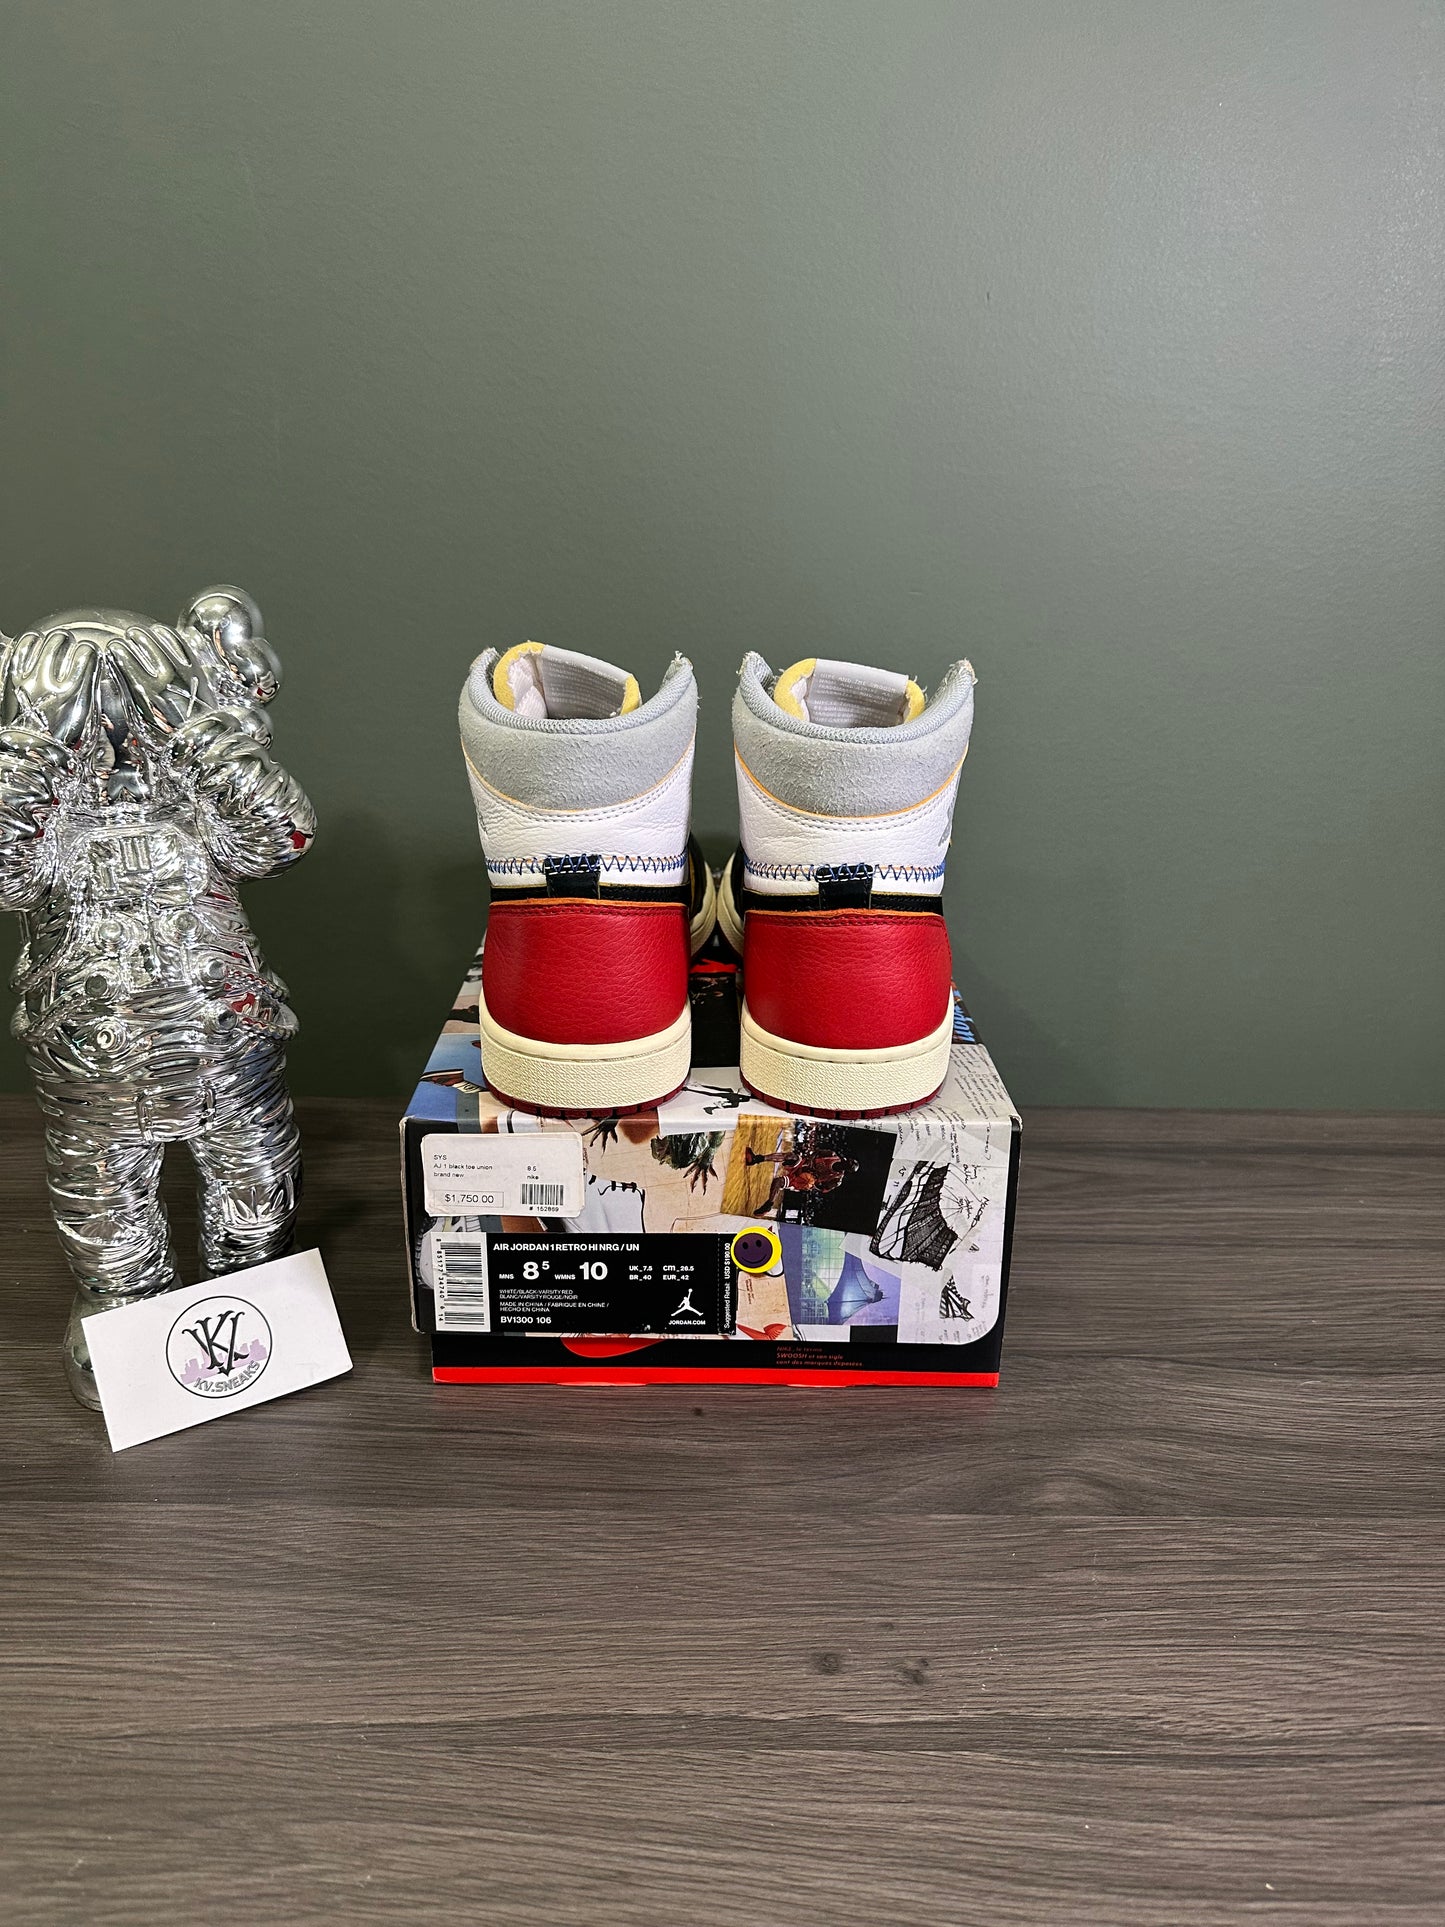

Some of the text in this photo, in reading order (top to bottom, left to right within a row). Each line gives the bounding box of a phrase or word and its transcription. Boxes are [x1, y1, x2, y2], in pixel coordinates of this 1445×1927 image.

[444, 1193, 495, 1204] $1,750.00
[493, 1243, 509, 1251] AIR
[510, 1243, 550, 1251] JORDAN
[550, 1243, 554, 1251] 1
[555, 1243, 588, 1251] RETRO
[588, 1243, 598, 1251] HI
[599, 1243, 620, 1251] NRG
[626, 1243, 639, 1251] UN
[579, 1261, 608, 1280] 10
[500, 1316, 552, 1324] BV1300 106
[724, 1299, 732, 1329] Suggested
[194, 1360, 260, 1392] KV.SNEAKS
